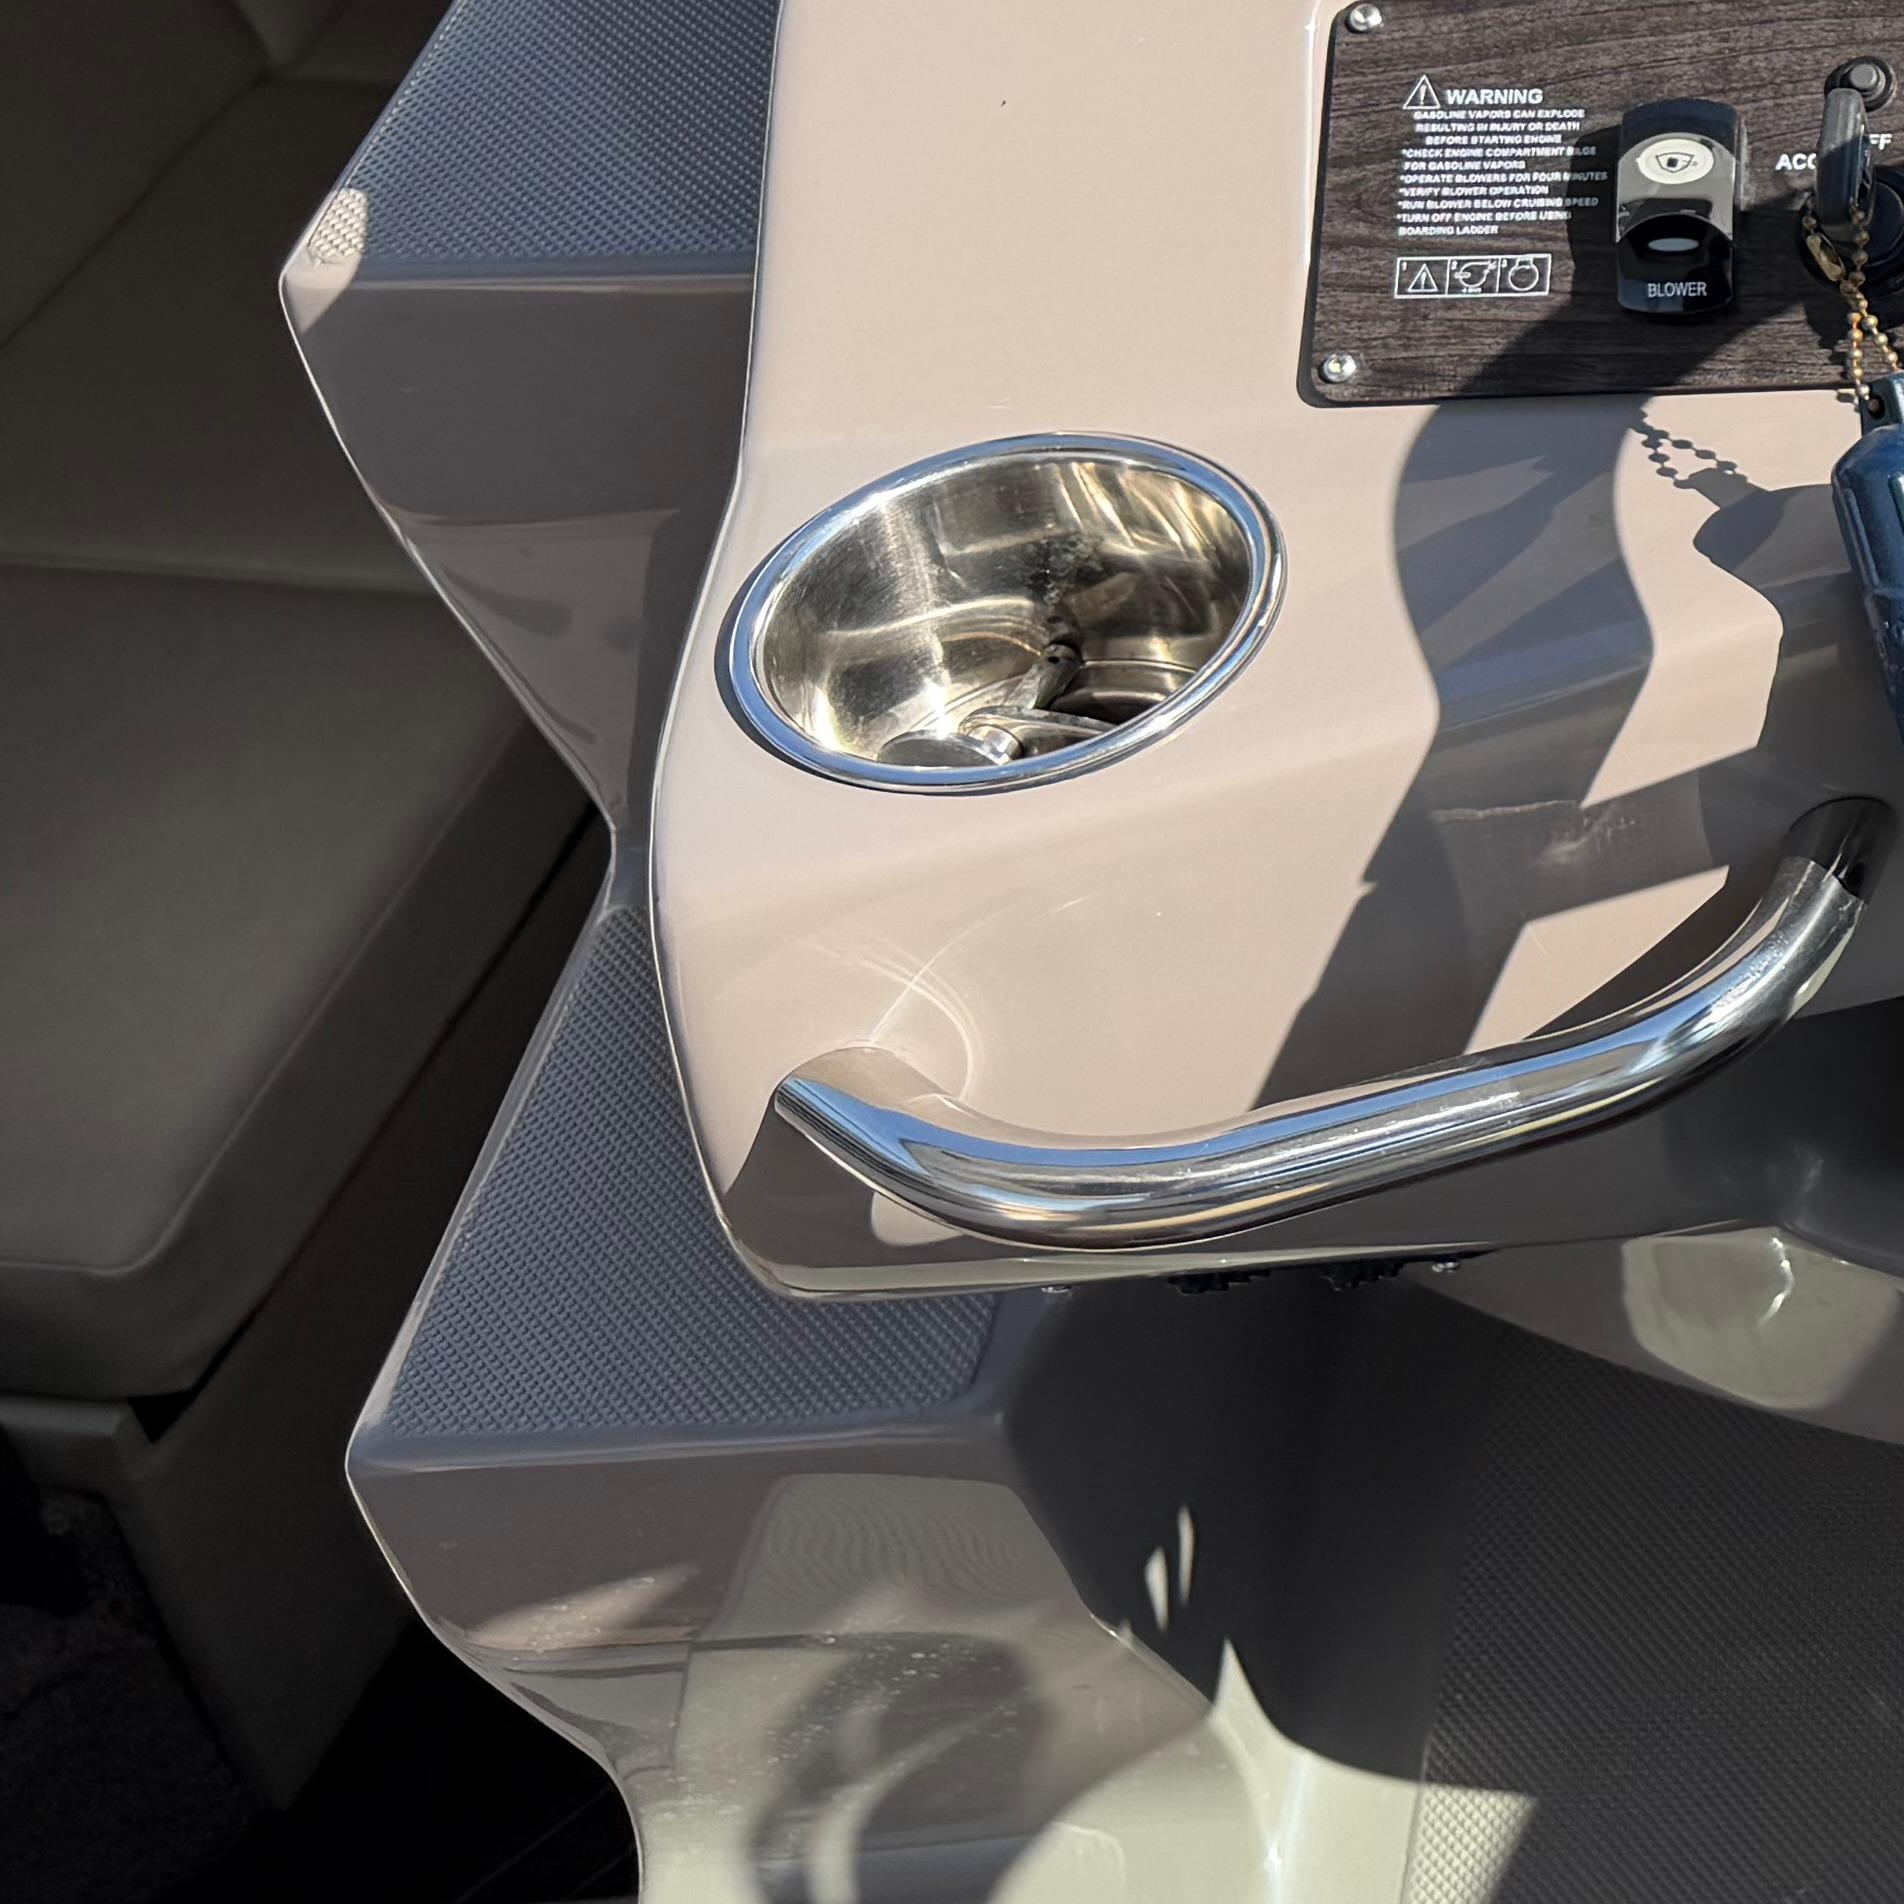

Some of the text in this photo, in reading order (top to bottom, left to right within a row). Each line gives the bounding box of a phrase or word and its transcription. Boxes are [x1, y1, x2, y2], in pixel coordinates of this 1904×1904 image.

[1446, 88, 1543, 105] WARNING
[1413, 108, 1586, 120] GASOLINE VAPORS CAN EXPLODE
[1416, 123, 1475, 133] RESULTING
[1489, 122, 1526, 132] INJURY
[1527, 122, 1544, 132] OR
[1545, 121, 1580, 131] DEATH
[1425, 134, 1562, 146] BEFORE STARTING ENGINE
[1445, 148, 1483, 157] ENGINE
[1485, 146, 1565, 157] COMPARTMENT
[1566, 146, 1597, 156] BILGE
[1403, 160, 1526, 171] FOR GASOLINE VAPORS
[1455, 173, 1507, 183] BLOWERS
[1508, 173, 1531, 182] FOR
[1532, 172, 1562, 182] FOUR
[1562, 171, 1608, 181] MINUTES
[1441, 187, 1487, 196] BLOWER
[1489, 185, 1549, 196] OPERATION
[1426, 200, 1472, 209] BLOWER
[1474, 199, 1512, 209] BELOW
[1513, 198, 1563, 208] CRUISING
[1564, 197, 1599, 207] SPEED
[1431, 213, 1452, 223] OFF
[1454, 212, 1493, 222] ENGINE
[1495, 211, 1538, 221] BEFORE
[1539, 210, 1572, 221] USING
[1398, 225, 1499, 236] BOARDING LADDER
[1648, 281, 1708, 298] BLOWER
